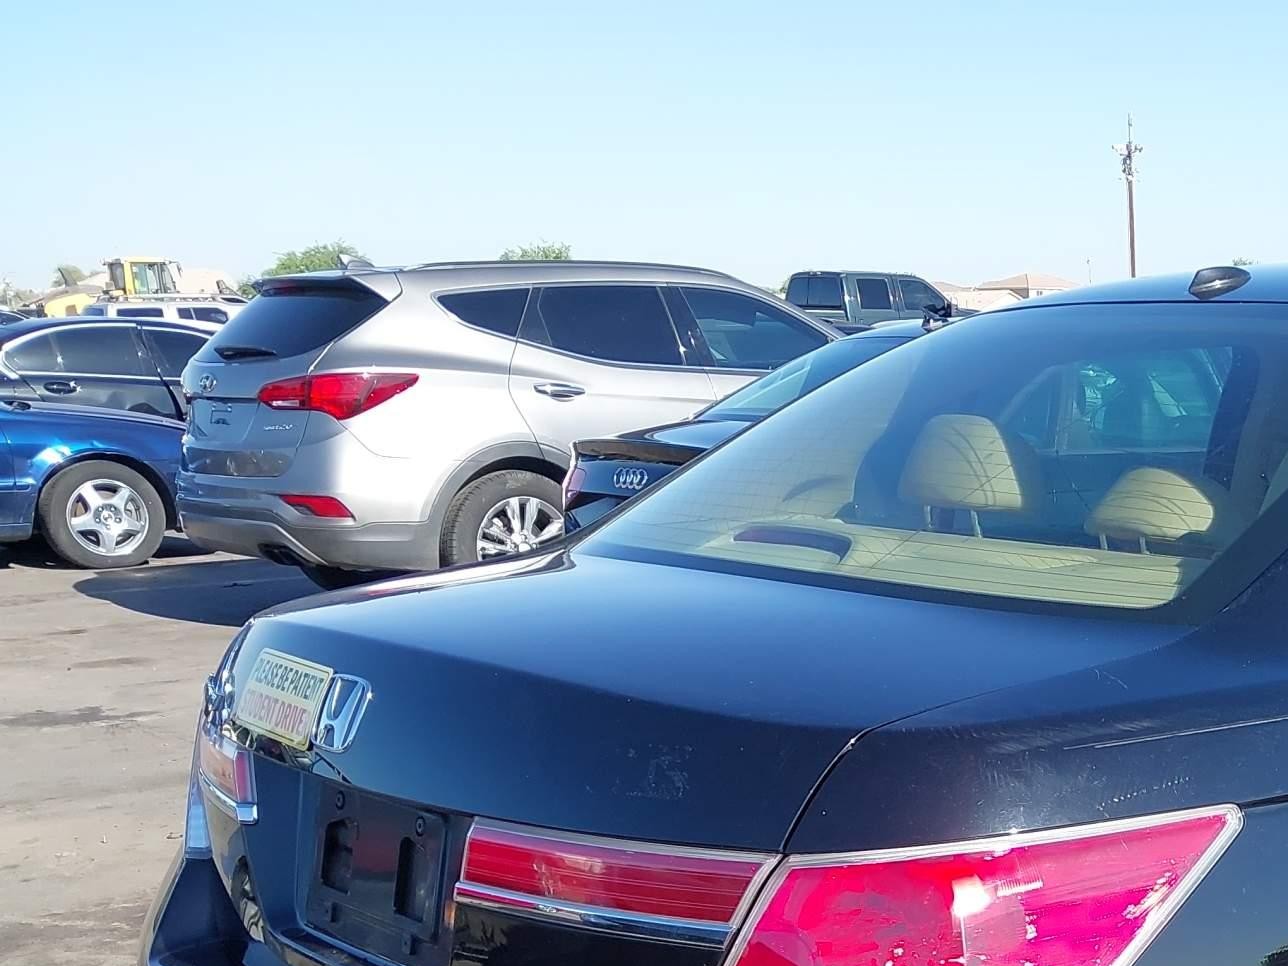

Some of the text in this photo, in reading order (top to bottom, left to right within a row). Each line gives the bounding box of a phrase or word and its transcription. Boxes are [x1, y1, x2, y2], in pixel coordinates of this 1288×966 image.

[252, 657, 324, 702] PLEASE BE PATIENT
[240, 688, 279, 726] STUDENT
